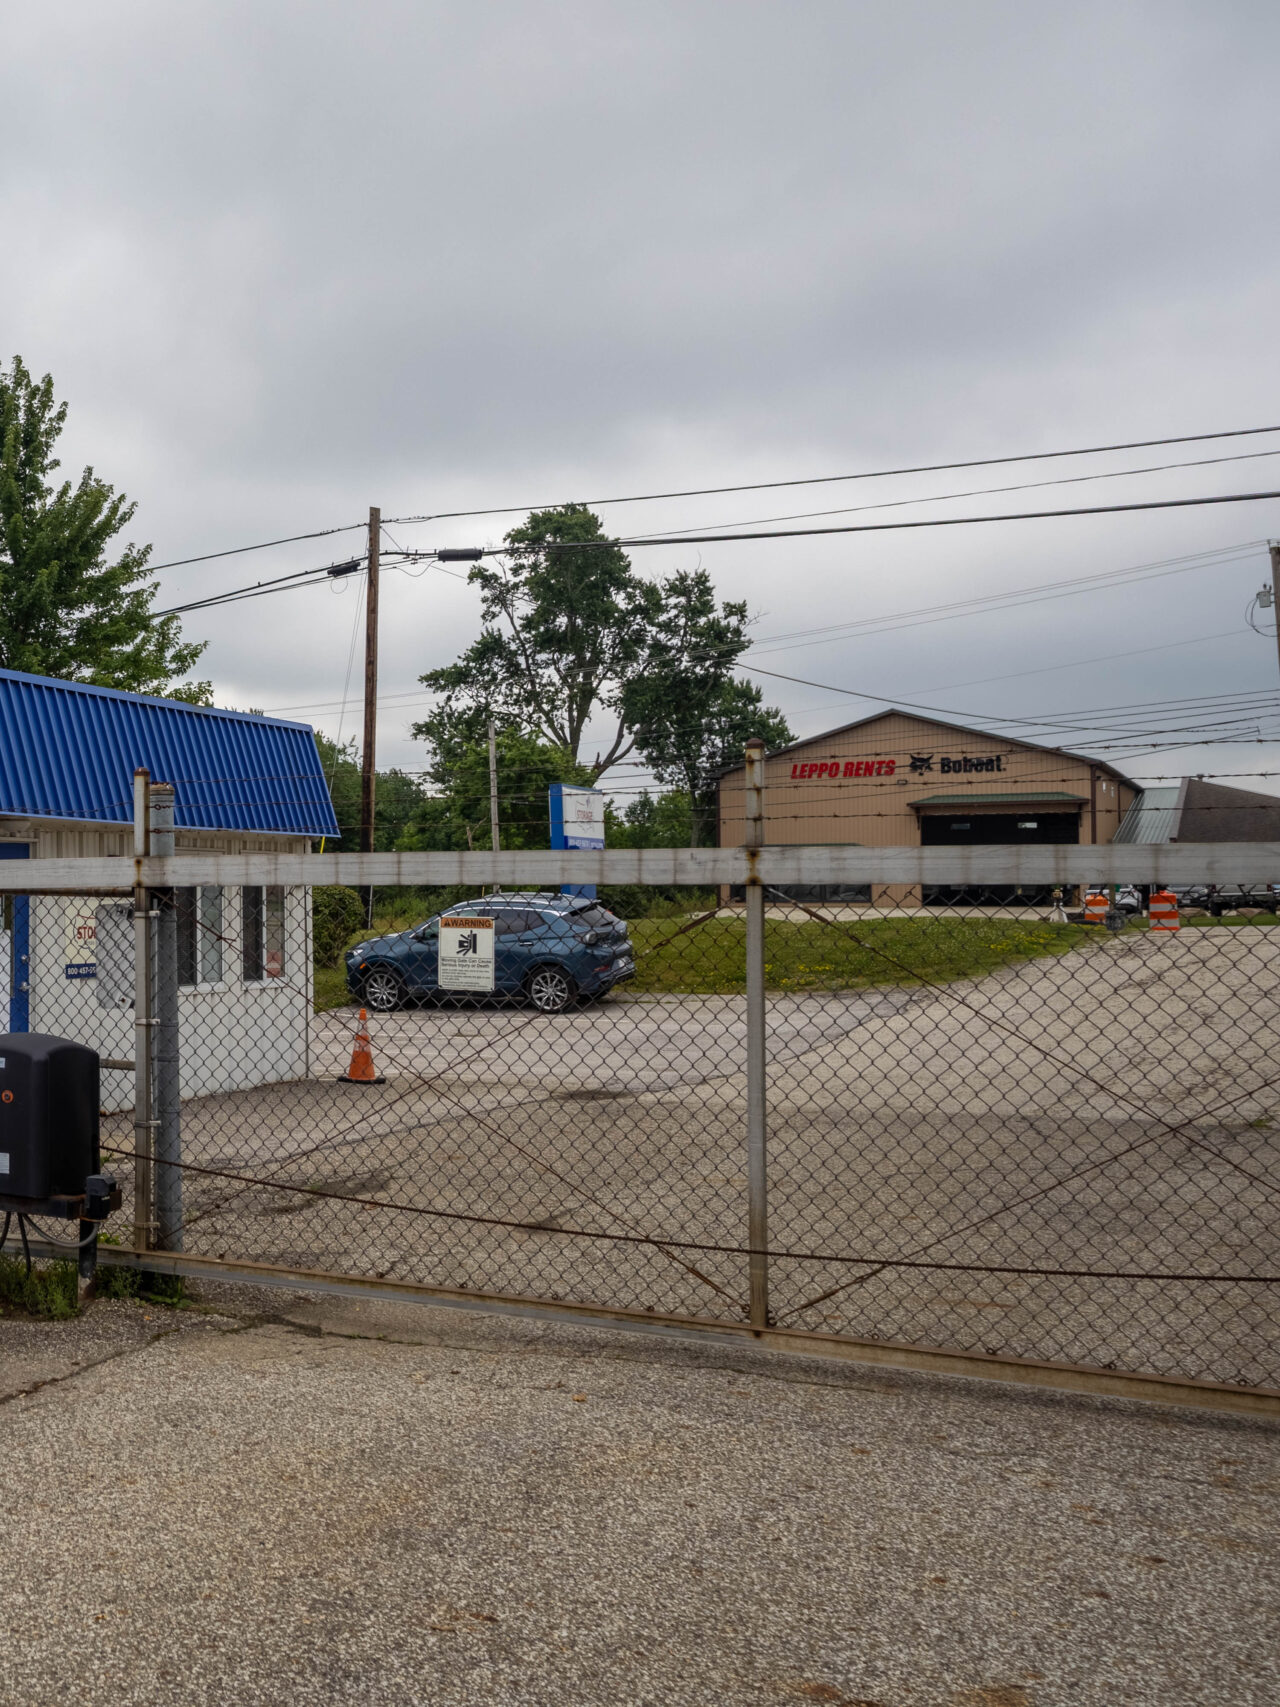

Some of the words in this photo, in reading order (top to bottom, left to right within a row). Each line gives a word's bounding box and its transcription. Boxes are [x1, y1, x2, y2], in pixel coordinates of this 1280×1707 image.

[791, 762, 840, 779] LEPPO
[843, 760, 896, 777] RENTS
[451, 919, 491, 928] WARNING
